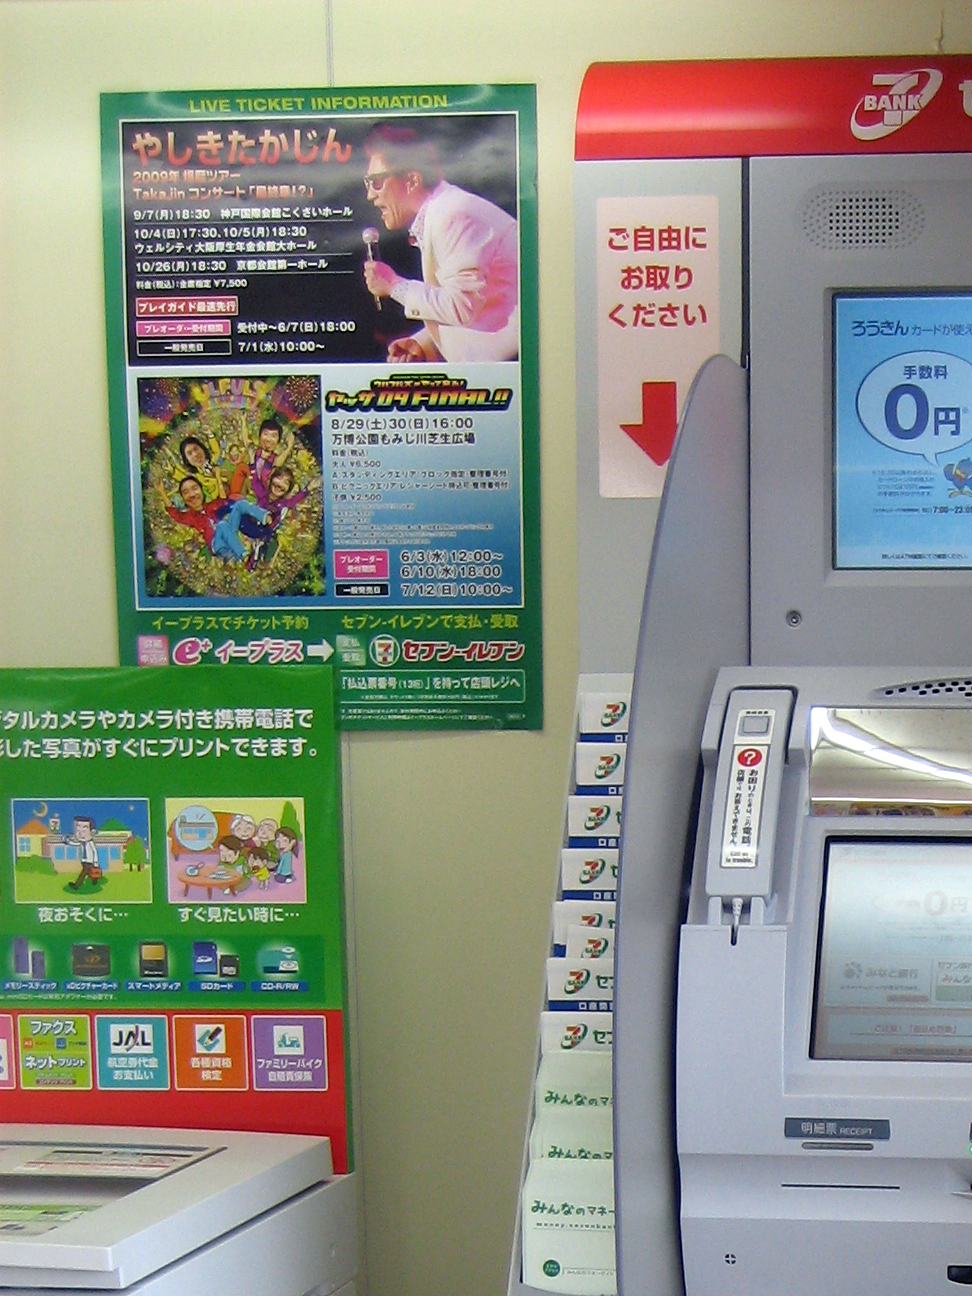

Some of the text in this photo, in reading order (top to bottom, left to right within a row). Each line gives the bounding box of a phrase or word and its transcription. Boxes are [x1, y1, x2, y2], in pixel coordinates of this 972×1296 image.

[188, 94, 449, 113] LIVE TICKET INFORMATION
[864, 93, 922, 111] BANK
[131, 127, 353, 167] やしきたかじん
[132, 187, 186, 201] Takajin
[133, 208, 211, 222] 9/7(月)18:30
[608, 225, 708, 252] ご自由に
[135, 260, 228, 273] 10/26(月)18:30
[620, 264, 694, 291] お取り
[608, 302, 708, 329] ください
[851, 320, 910, 337] ろうきん
[903, 365, 949, 380] 手数料
[331, 432, 476, 446] 万博公園もみじ川芝生広場
[400, 564, 502, 579] 6/10(水)18:00
[152, 614, 519, 631] イープラスでチケット予約 セブン-イレブンで支払・受取
[215, 637, 304, 664] イープラス
[30, 1020, 77, 1036] ファクス
[112, 1028, 153, 1050] JAL
[544, 1090, 613, 1107] みんなのマ
[801, 1121, 875, 1136] 明細票 RECEIPT
[531, 1199, 616, 1217] みんなのマネー
